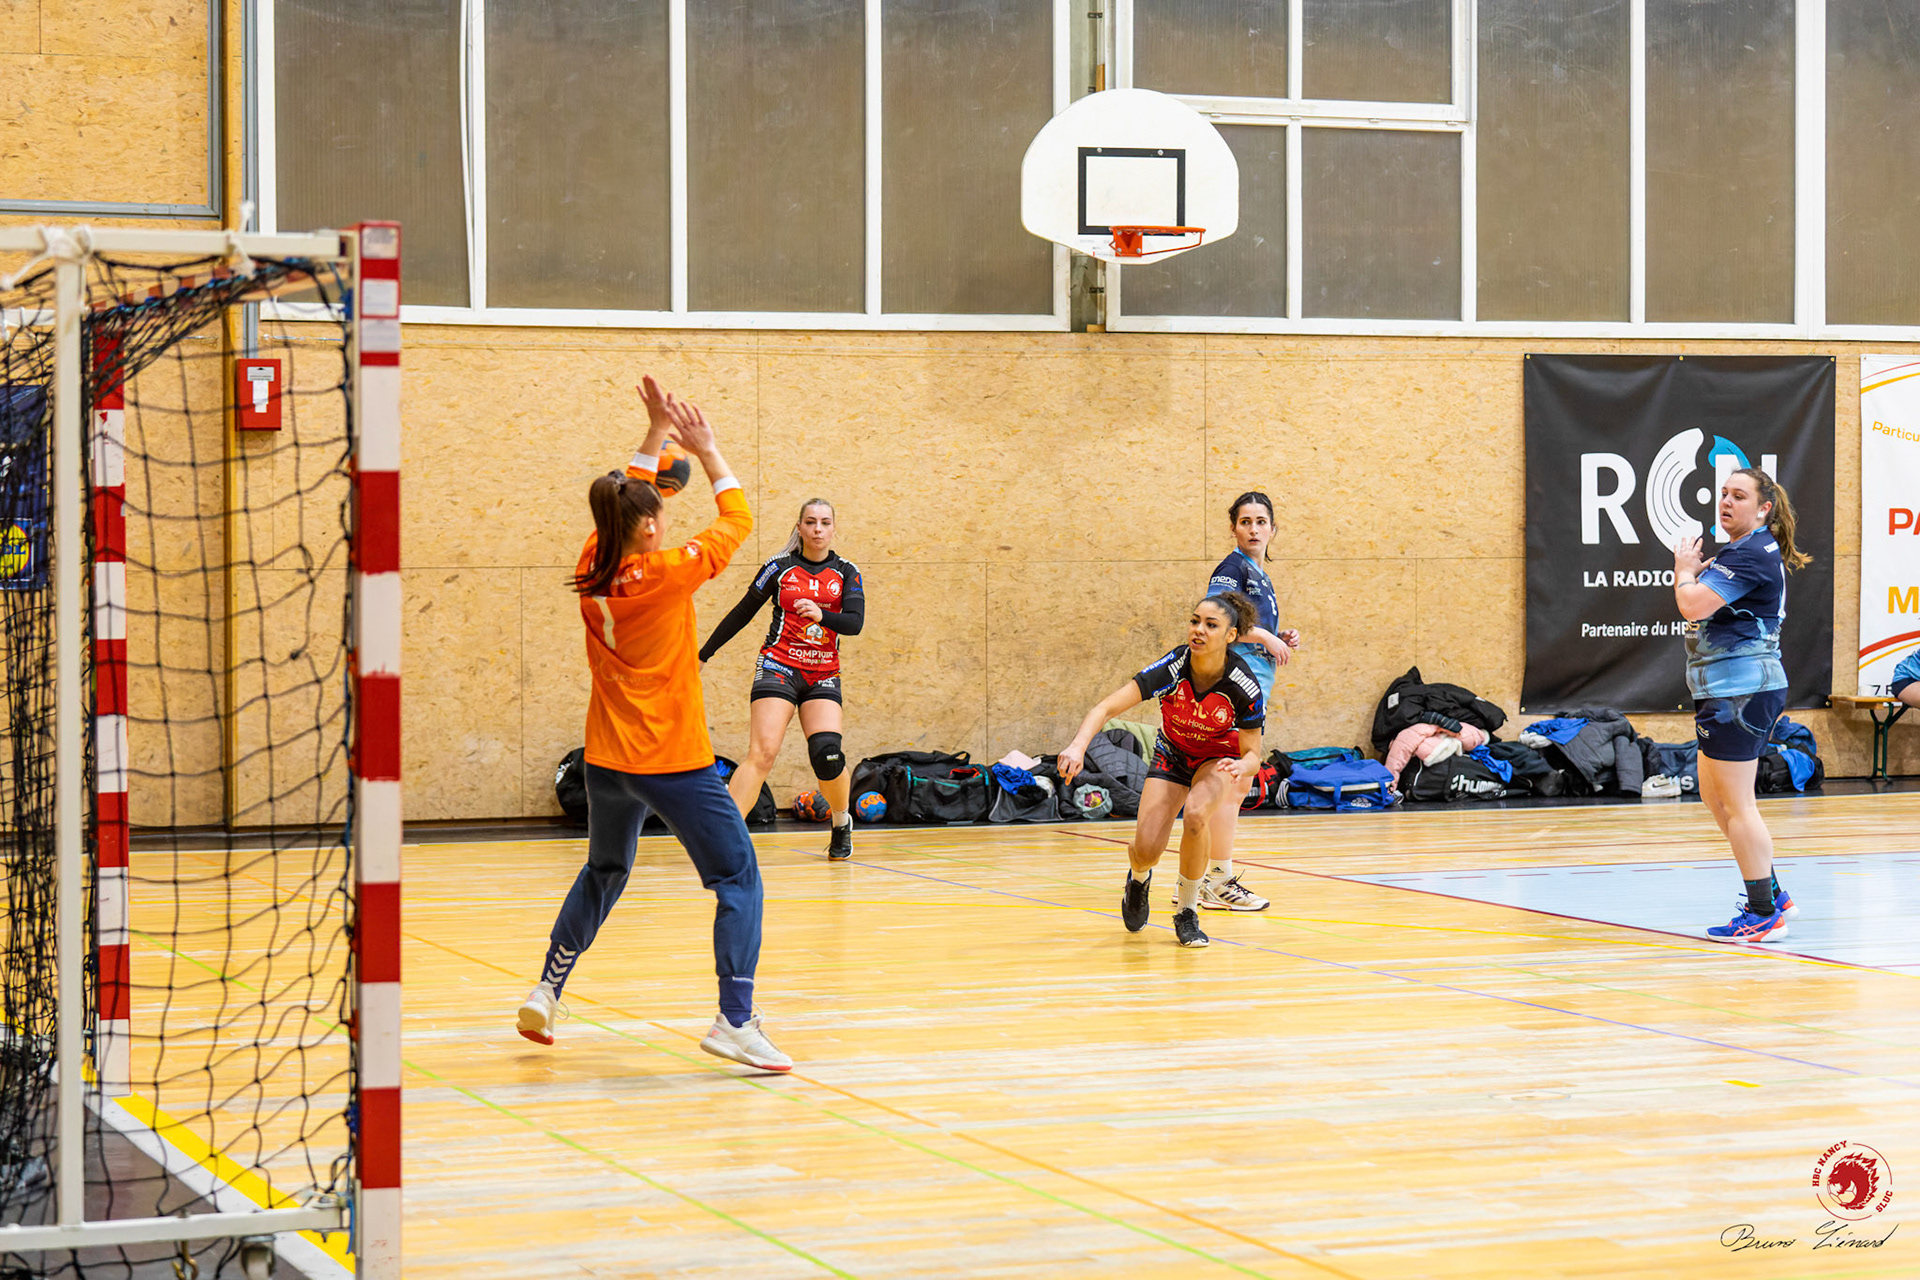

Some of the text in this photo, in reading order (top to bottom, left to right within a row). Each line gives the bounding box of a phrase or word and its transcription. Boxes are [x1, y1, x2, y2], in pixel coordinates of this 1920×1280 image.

[1888, 507, 1920, 536] P
[1583, 569, 1675, 588] LA RADIO
[1581, 621, 1649, 638] Partenaire
[1650, 620, 1668, 637] du
